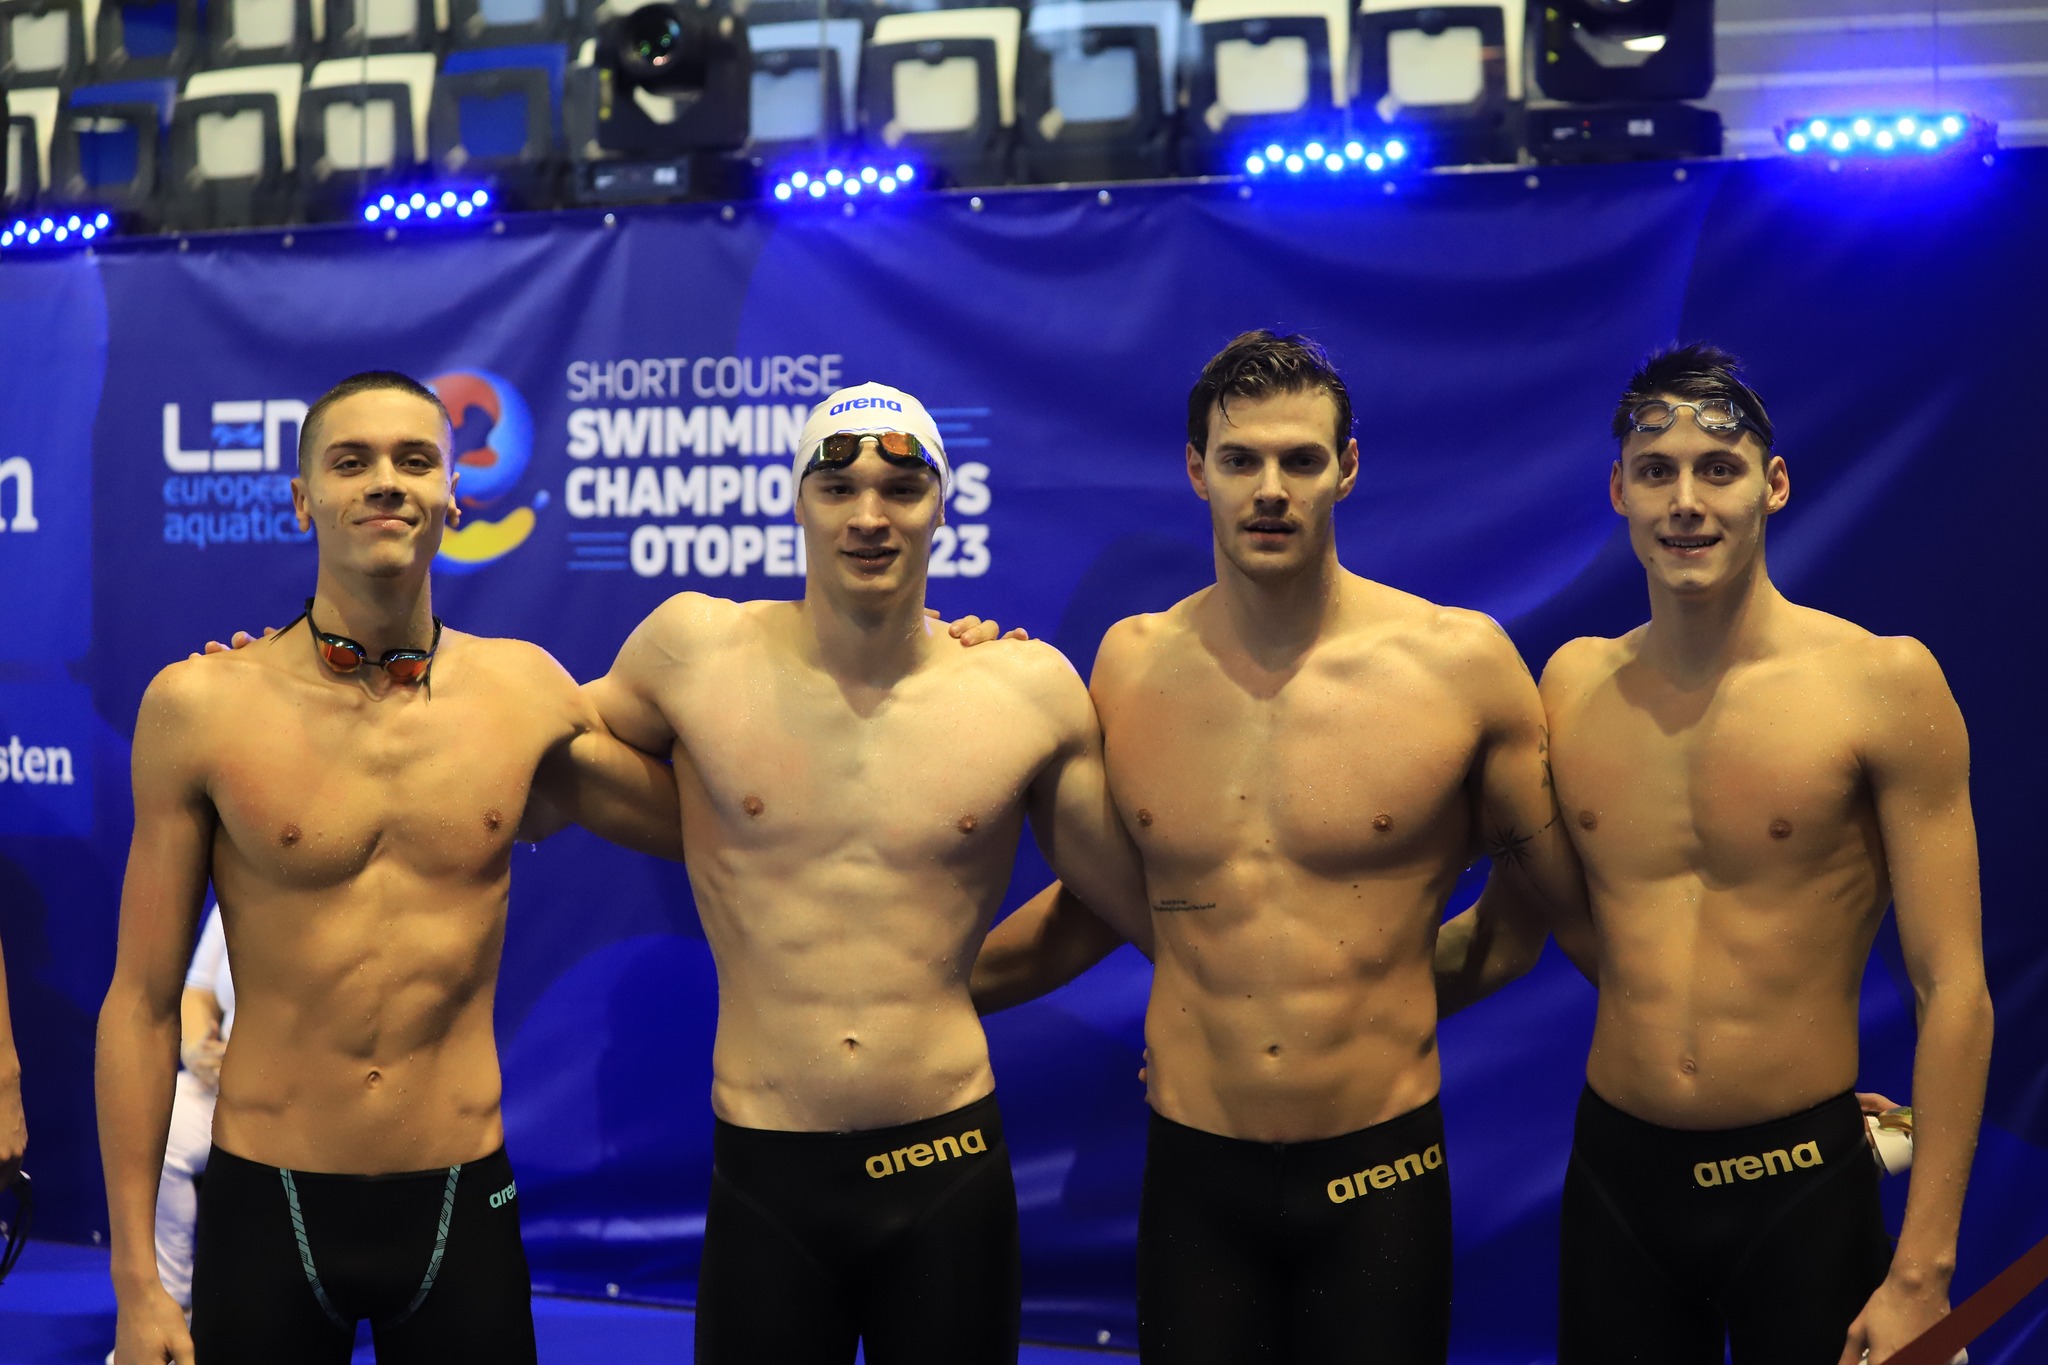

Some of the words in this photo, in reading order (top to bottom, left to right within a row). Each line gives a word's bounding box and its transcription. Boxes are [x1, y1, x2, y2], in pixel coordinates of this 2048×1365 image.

[566, 358, 688, 402] SHORT
[692, 353, 843, 398] COURSE
[829, 397, 902, 416] arena
[566, 404, 808, 461] SWIMMIN
[163, 474, 293, 509] europea
[630, 523, 808, 578] OTOPE
[926, 523, 992, 578] 23
[865, 1128, 988, 1179] arena
[1327, 1142, 1443, 1204] arena
[1693, 1140, 1824, 1188] arena
